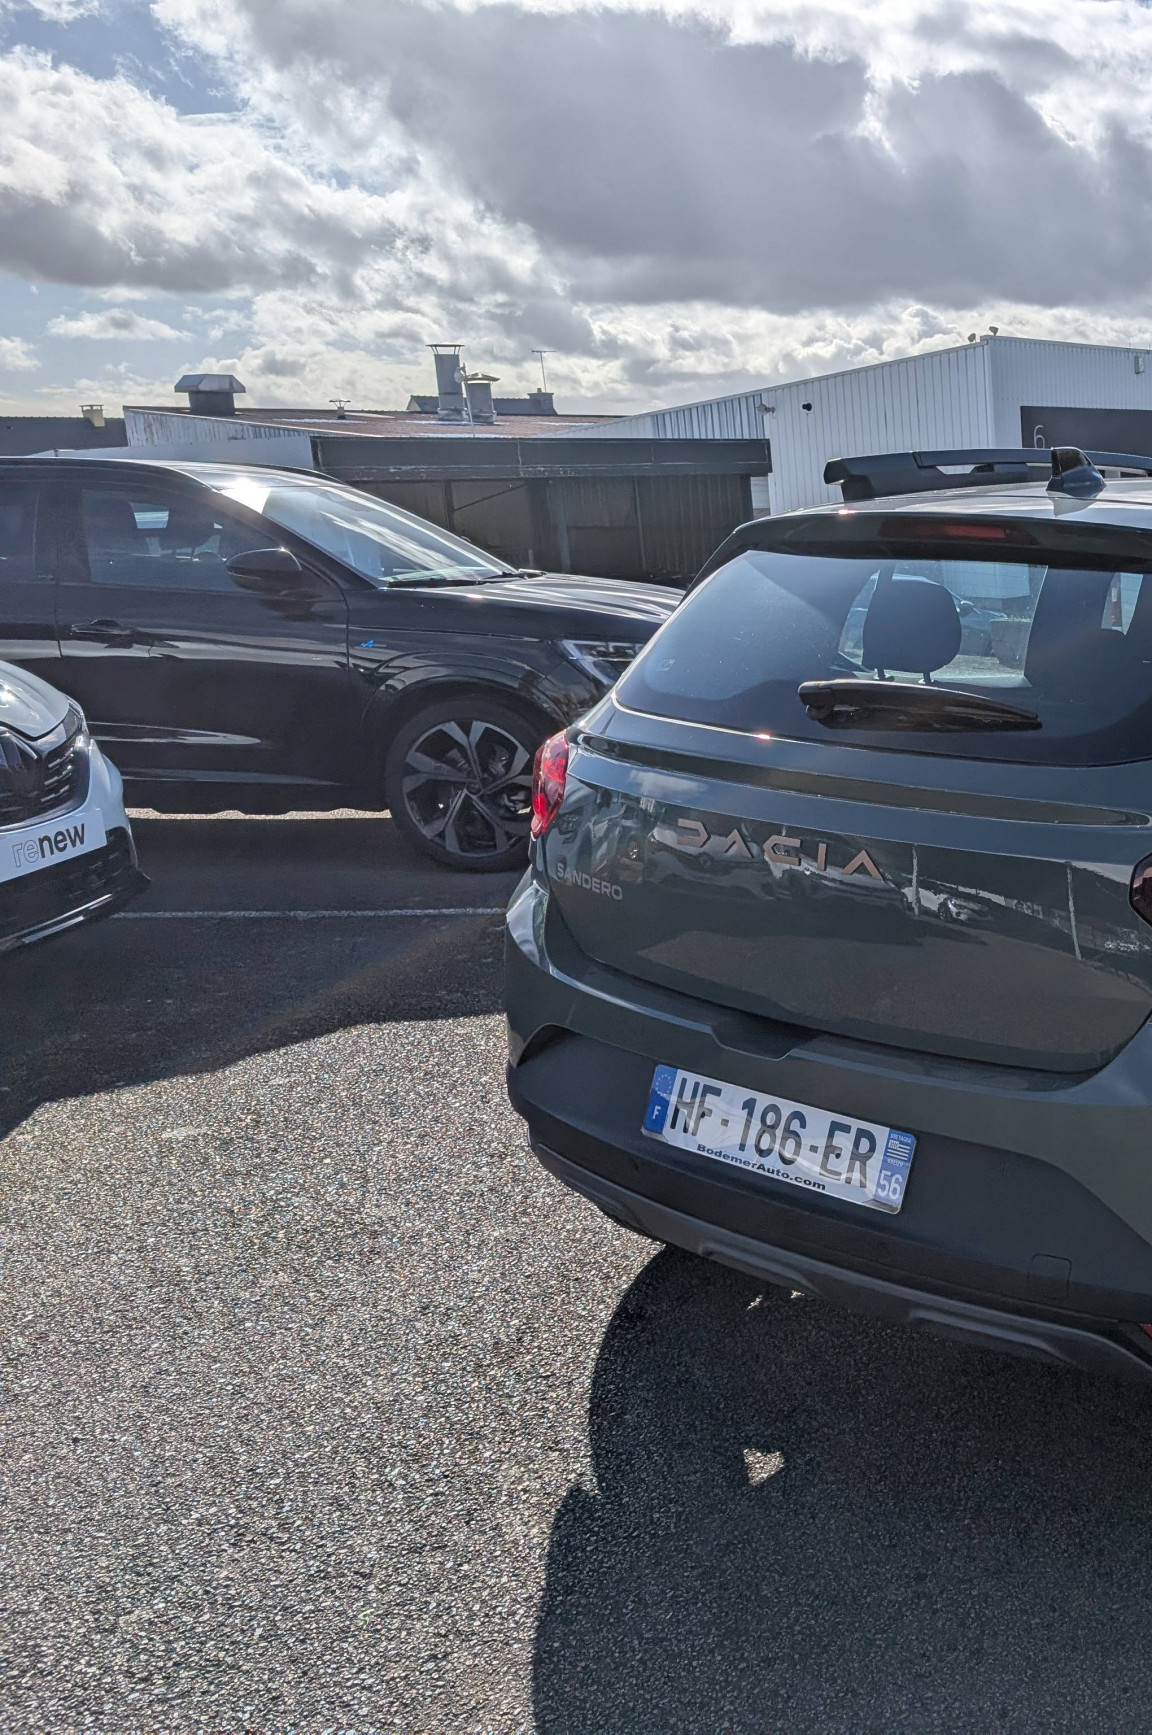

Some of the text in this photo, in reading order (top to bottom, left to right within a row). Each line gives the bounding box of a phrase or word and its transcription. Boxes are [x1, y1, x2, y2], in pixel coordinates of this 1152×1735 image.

[1033, 425, 1046, 449] 6
[12, 823, 85, 868] renew
[677, 818, 884, 881] DACIA
[557, 862, 623, 900] SANDERO
[652, 1105, 662, 1121] F
[696, 1144, 827, 1191] BodemerAuto.com
[877, 1169, 903, 1200] 56
